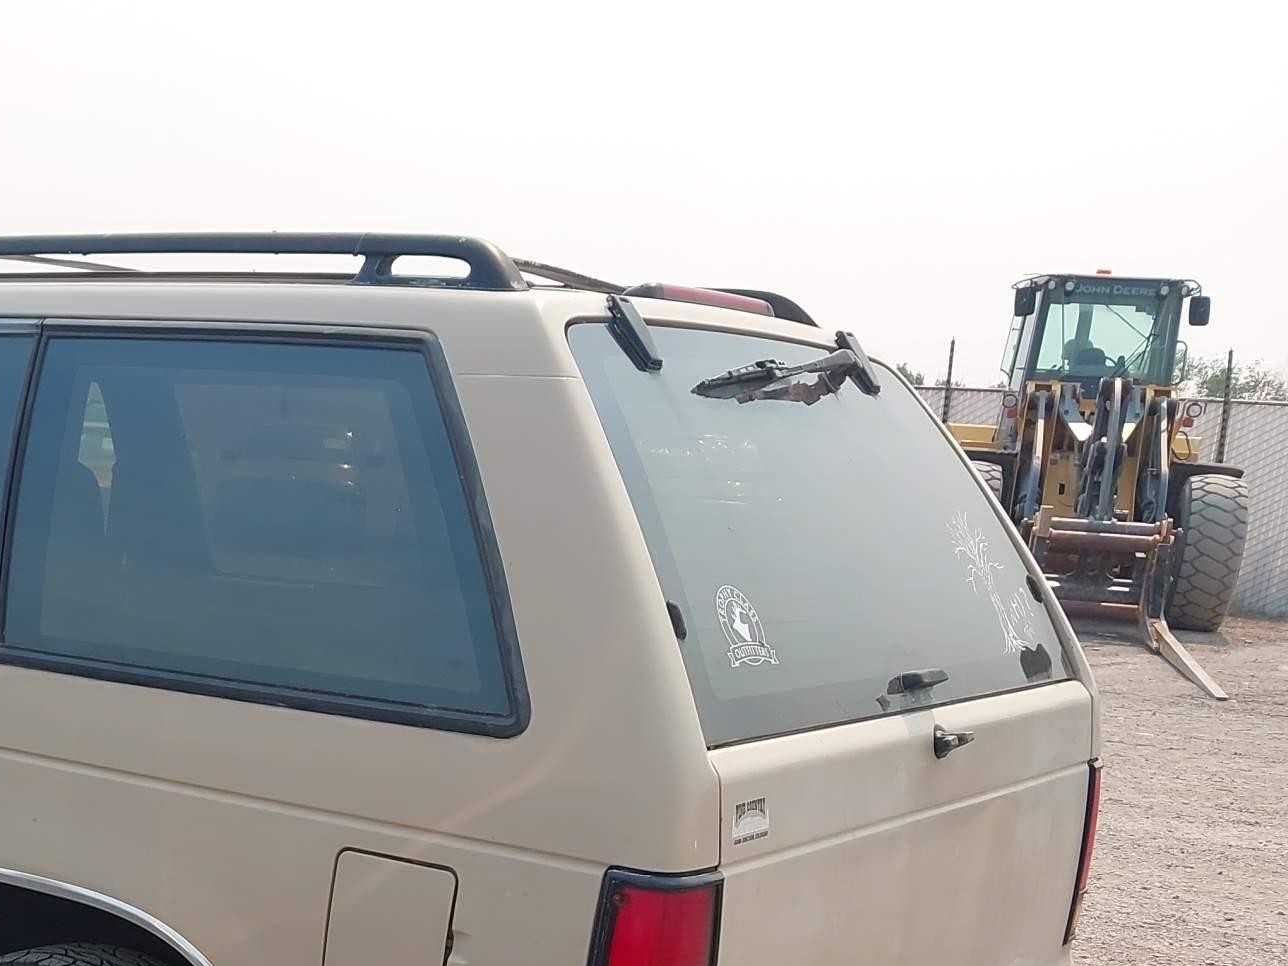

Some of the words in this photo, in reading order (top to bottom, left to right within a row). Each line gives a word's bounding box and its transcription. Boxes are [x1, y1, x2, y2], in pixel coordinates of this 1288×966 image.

[1075, 283, 1111, 294] JOHN
[1113, 285, 1157, 296] DEERE
[733, 591, 758, 623] CLASS
[734, 646, 770, 659] OUTFITTERS
